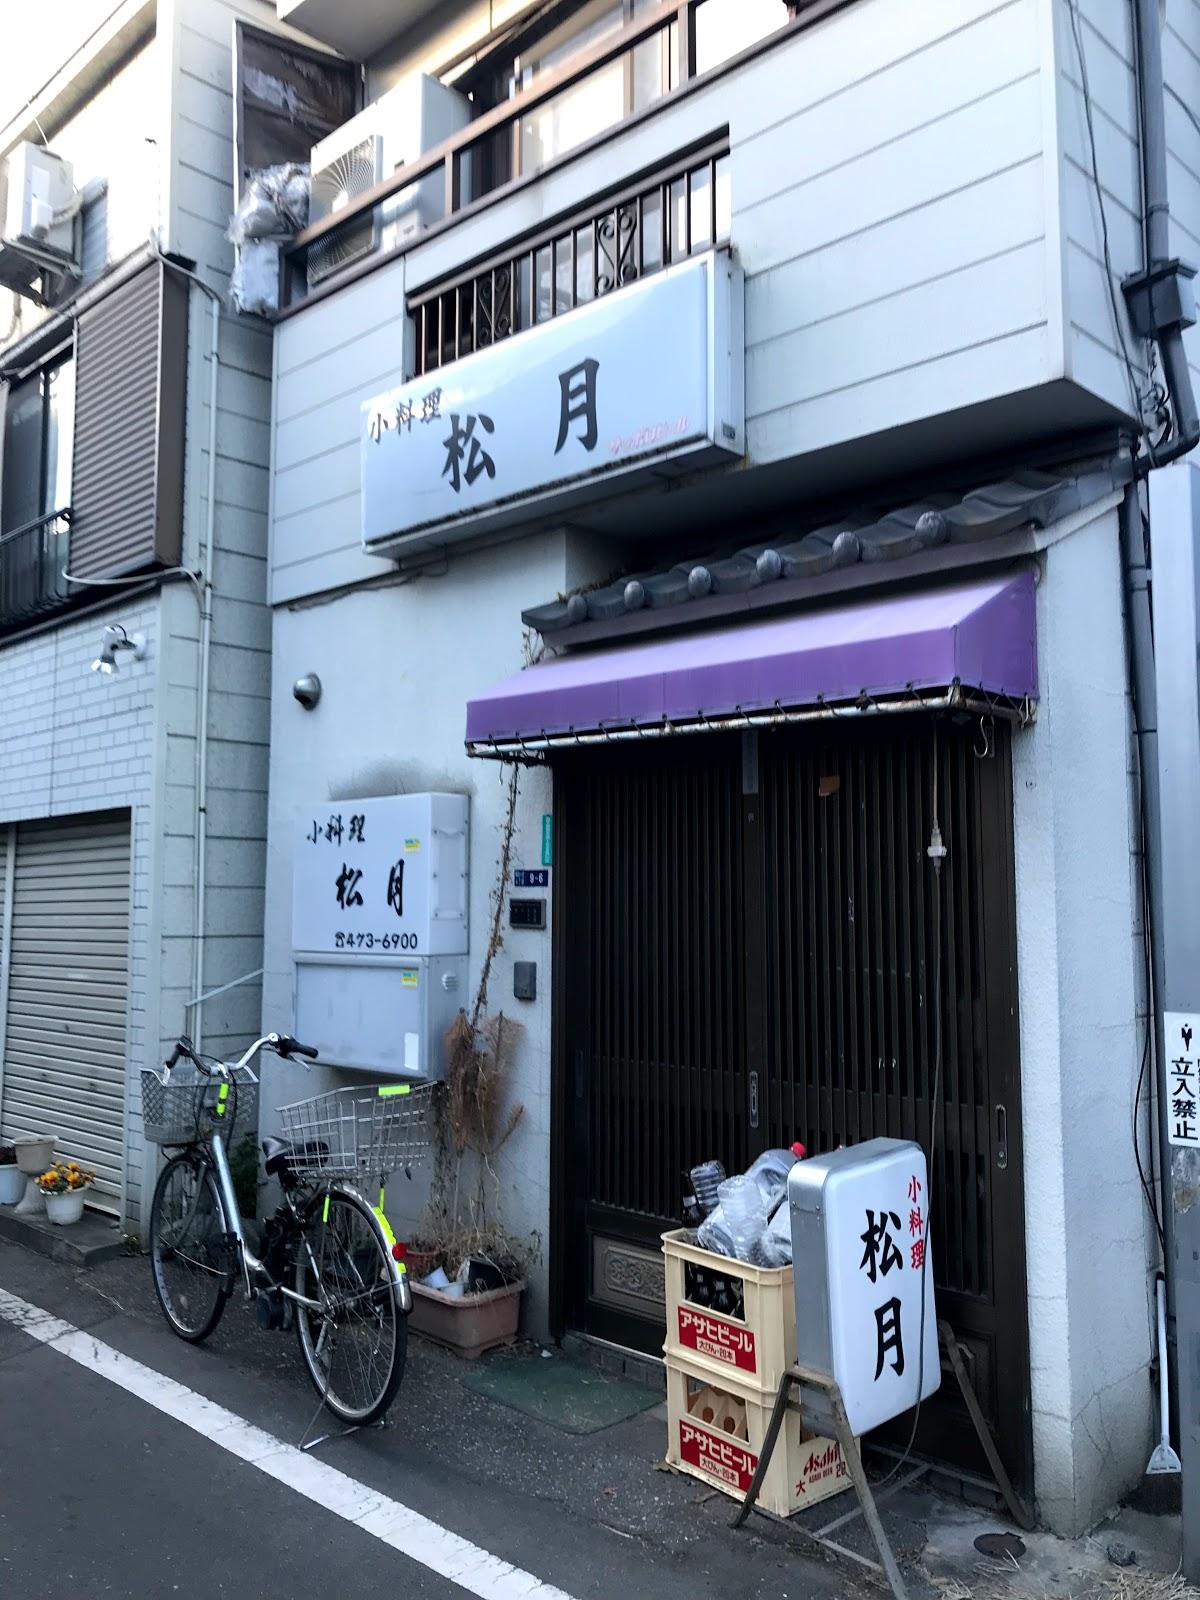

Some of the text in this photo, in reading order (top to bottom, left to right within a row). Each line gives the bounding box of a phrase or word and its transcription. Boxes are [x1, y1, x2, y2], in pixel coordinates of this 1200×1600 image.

[370, 387, 443, 444] 小料理
[442, 357, 600, 493] 松月
[306, 813, 366, 847] 小料理
[335, 858, 405, 917] 松月
[346, 932, 418, 949] 473-6900
[1170, 1057, 1198, 1141] 立入禁止
[907, 1174, 925, 1269] 小料理
[860, 1208, 905, 1382] 松月
[679, 1310, 753, 1352] アサヒビール
[681, 1425, 756, 1477] アサヒビール
[803, 1443, 843, 1476] Asahi
[796, 1480, 806, 1496] 大
